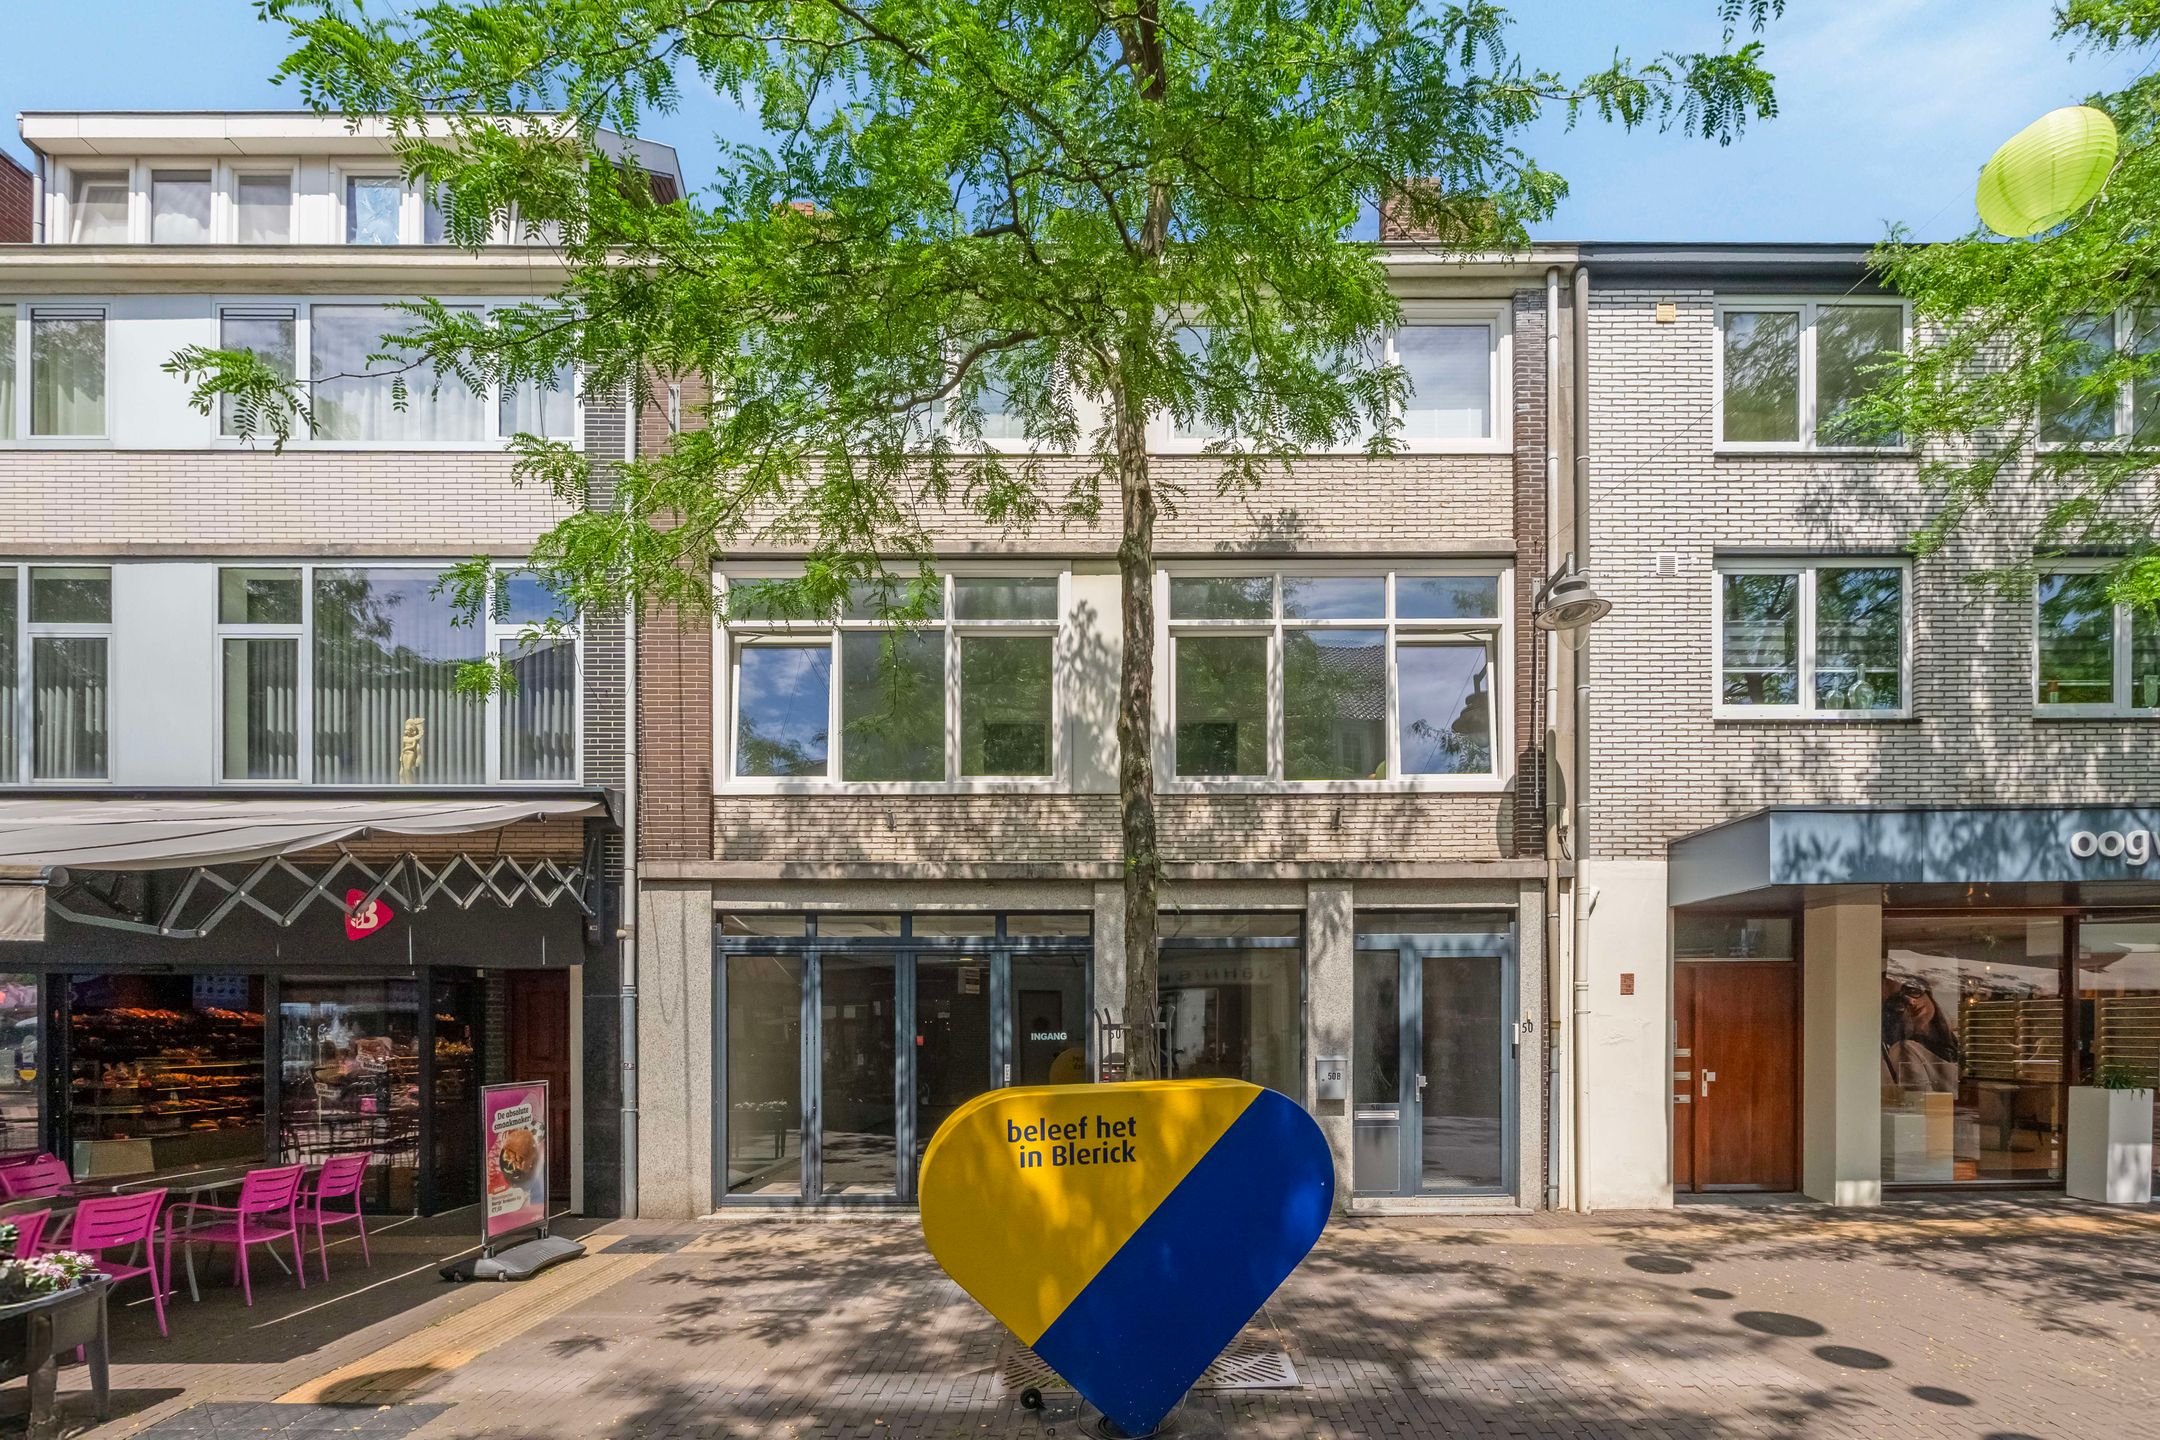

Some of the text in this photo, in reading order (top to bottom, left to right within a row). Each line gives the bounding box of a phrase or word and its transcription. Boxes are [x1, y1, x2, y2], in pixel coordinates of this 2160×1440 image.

[1521, 1021, 1534, 1034] 50
[1030, 1032, 1068, 1041] INGANG
[1327, 1072, 1341, 1081] 50B
[497, 1106, 529, 1120] De absolute
[494, 1114, 532, 1130] smaakmaker!
[1007, 1115, 1137, 1143] beleef het
[1019, 1139, 1137, 1168] in Blerick
